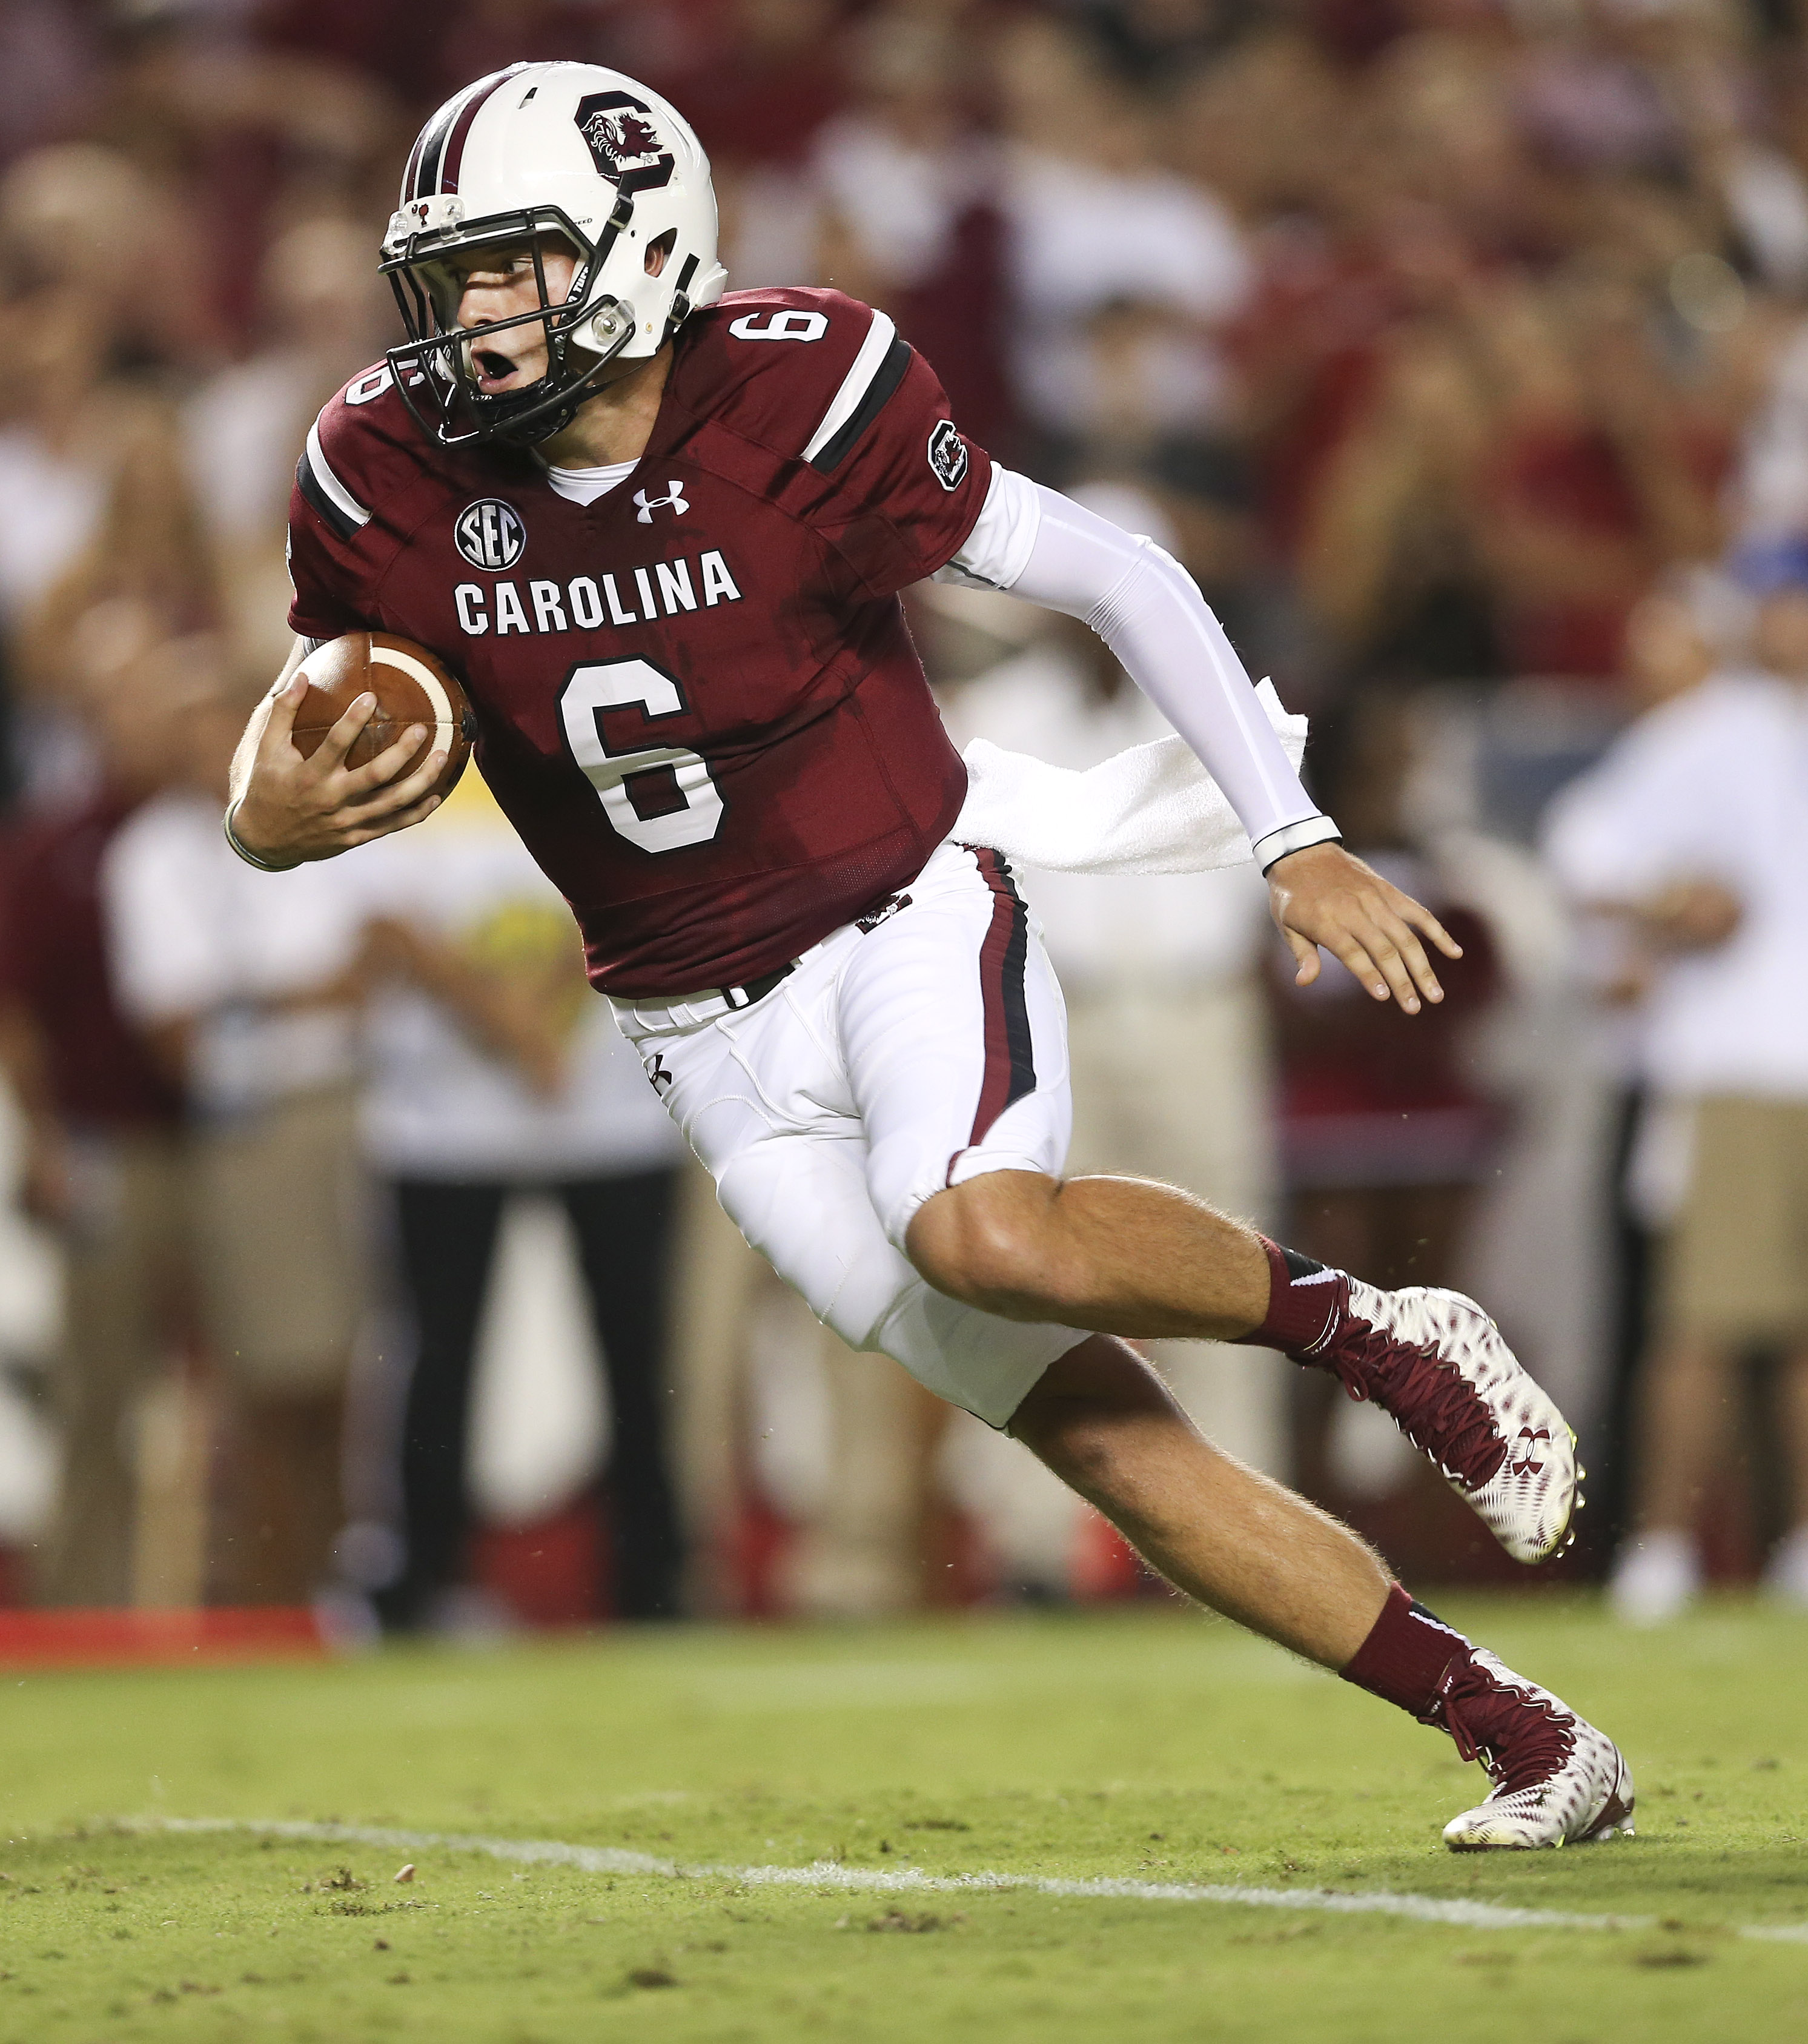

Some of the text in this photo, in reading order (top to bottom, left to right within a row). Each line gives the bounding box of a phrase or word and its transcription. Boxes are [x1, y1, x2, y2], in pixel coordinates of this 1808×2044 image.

[728, 309, 830, 343] 6
[460, 504, 519, 566] SEC
[453, 549, 743, 637] CAROLINA
[558, 657, 726, 855] 6
